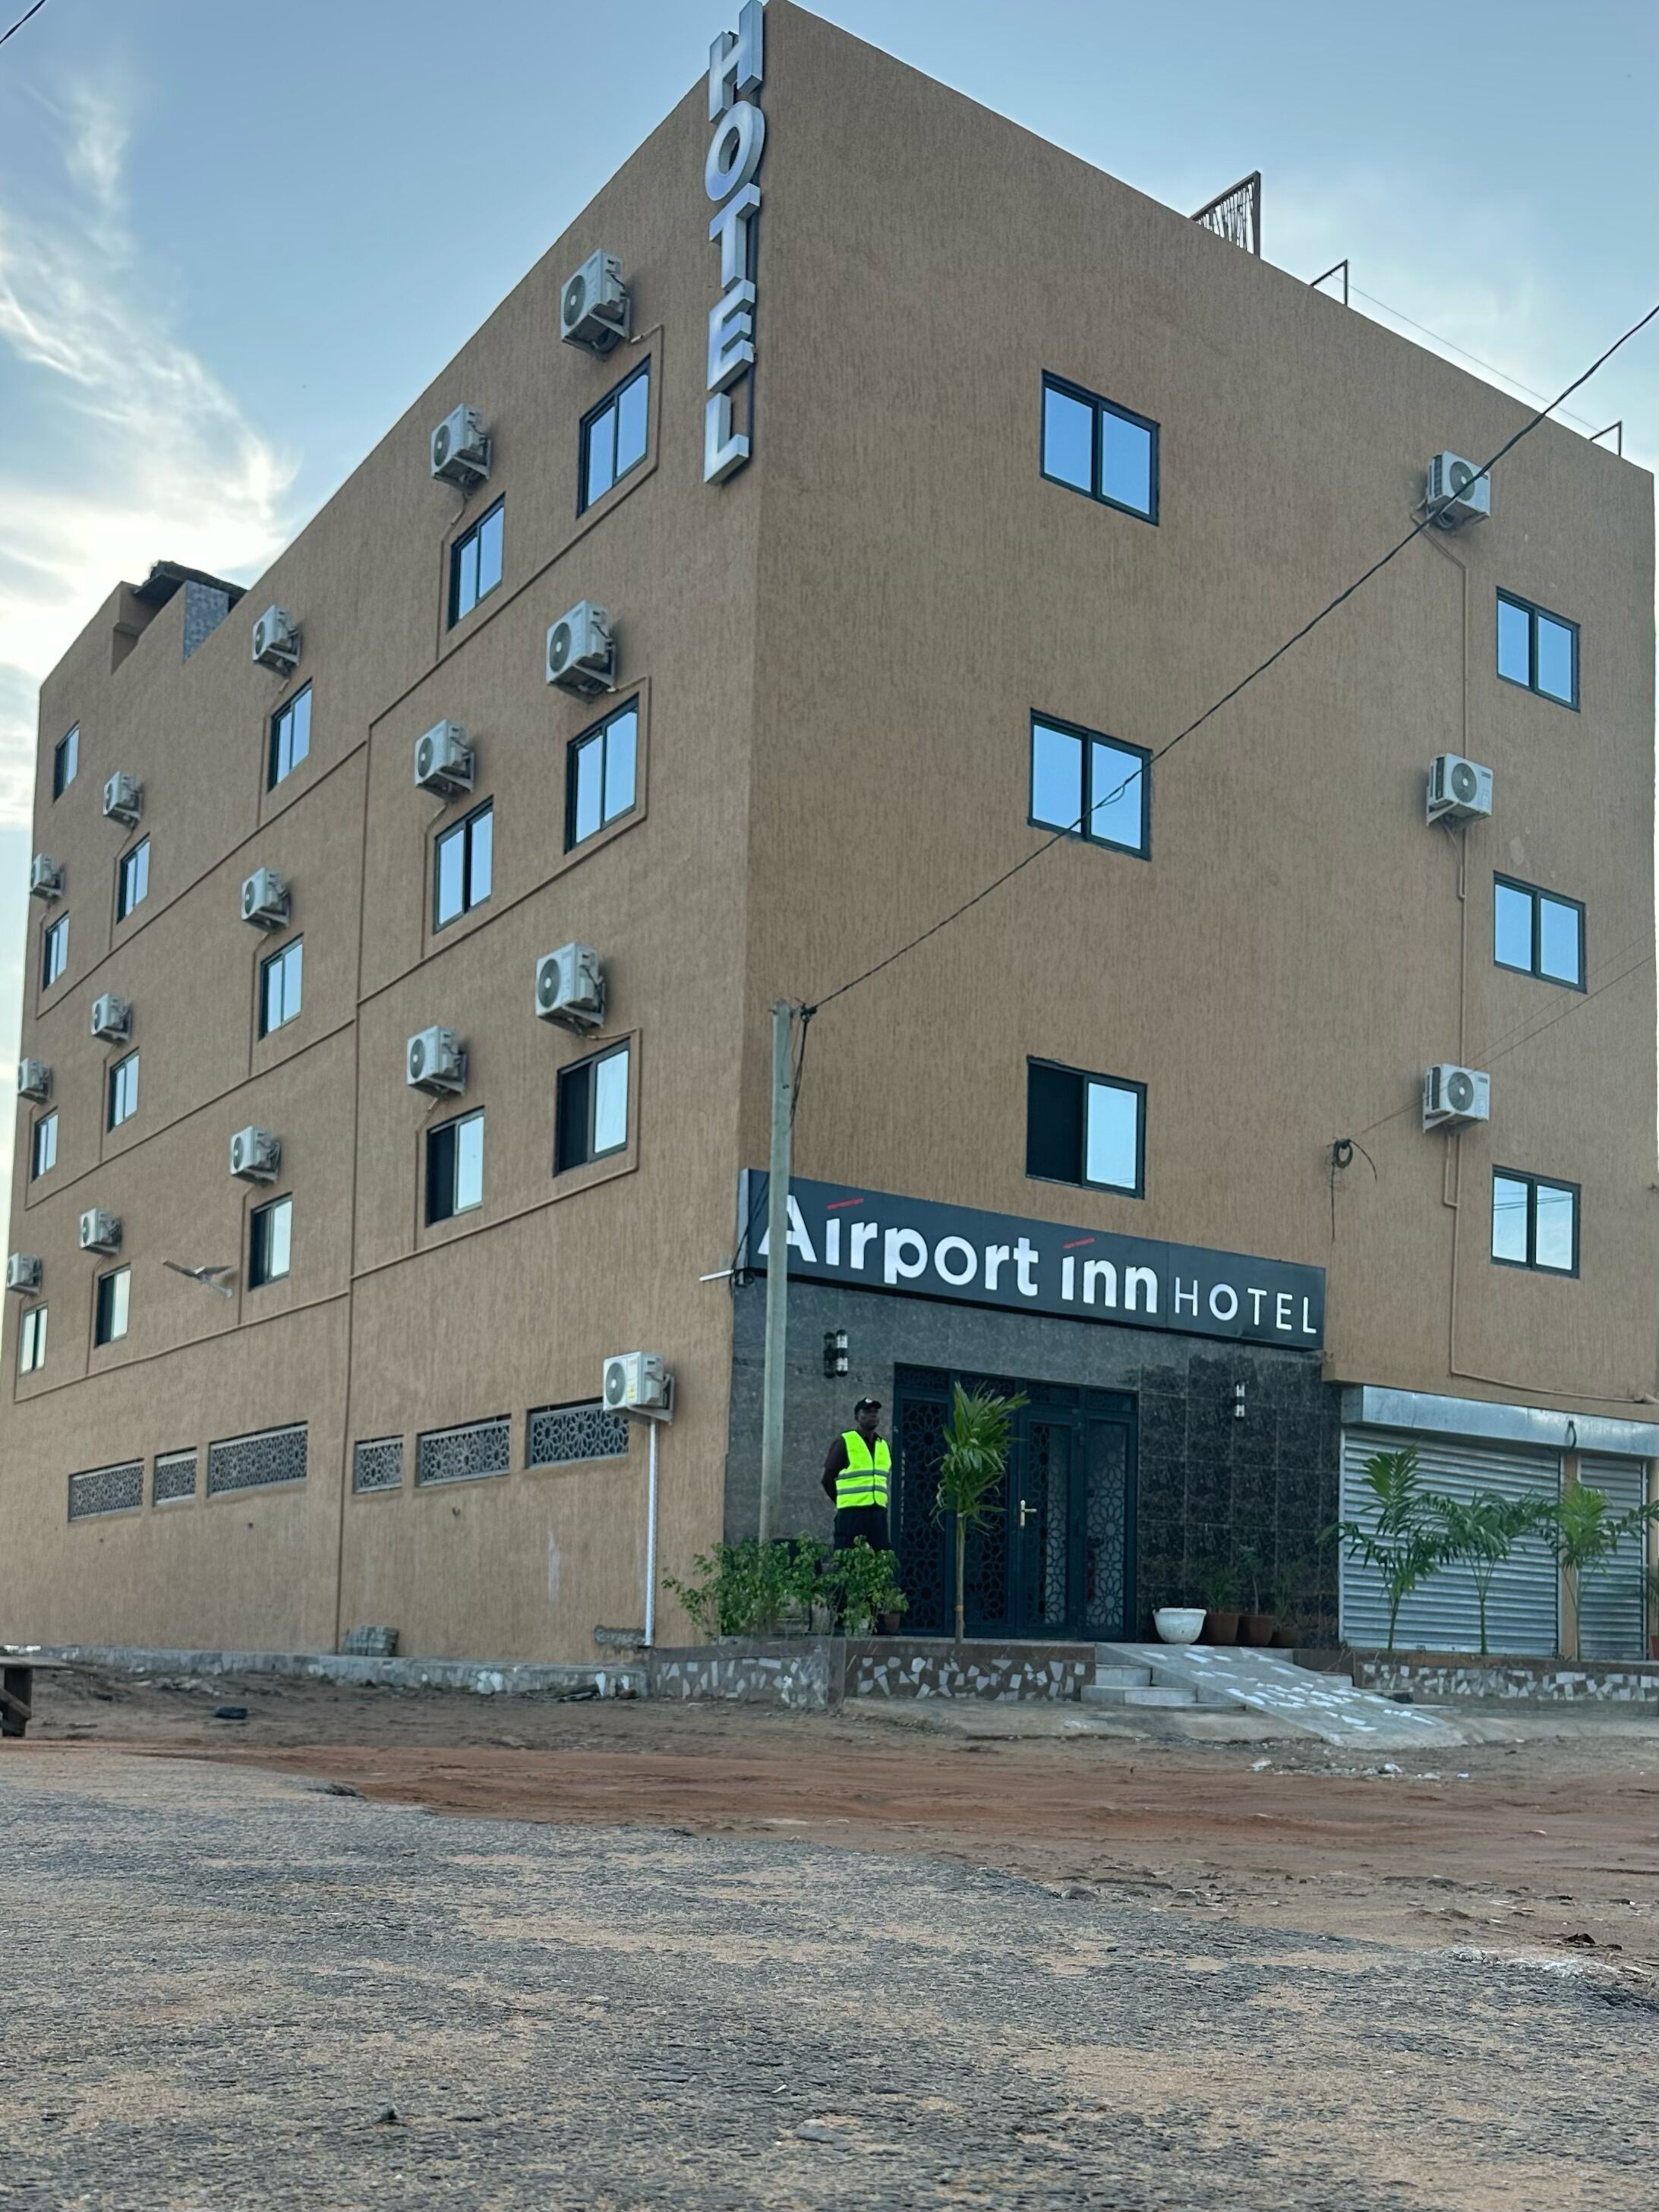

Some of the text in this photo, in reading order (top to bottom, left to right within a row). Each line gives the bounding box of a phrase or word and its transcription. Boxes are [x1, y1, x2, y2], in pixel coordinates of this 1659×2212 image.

[705, 0, 764, 484] HOTEL
[758, 1194, 1317, 1333] Airport inn HOTEL
